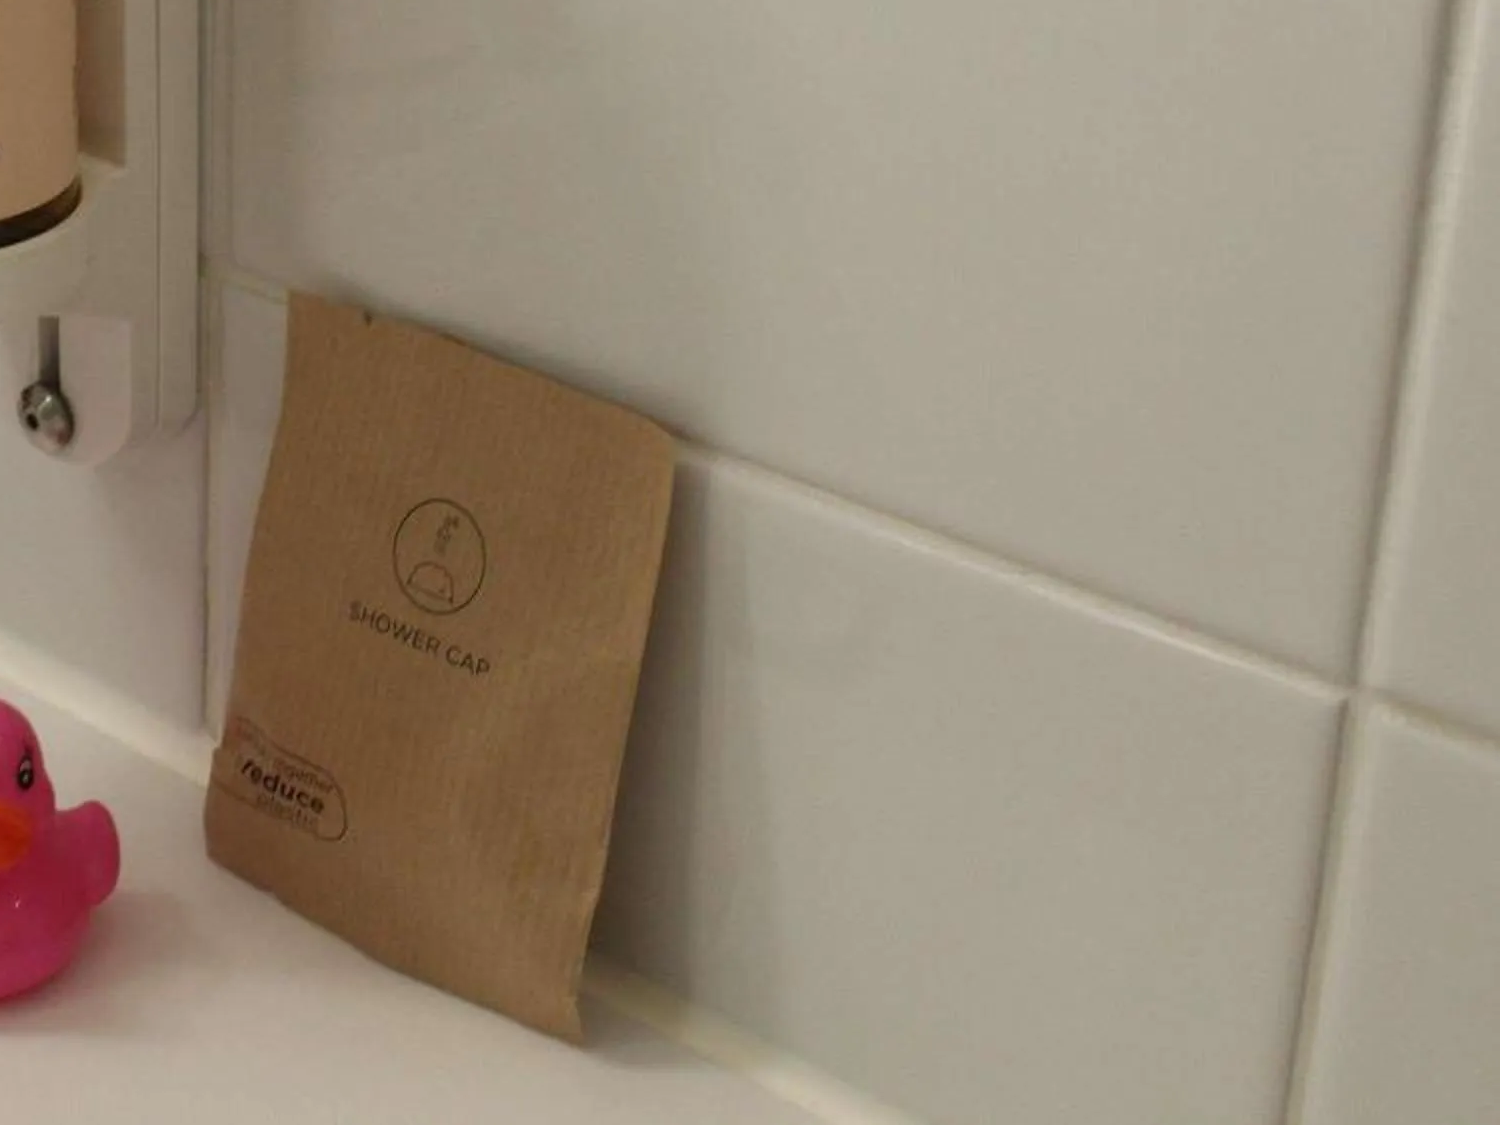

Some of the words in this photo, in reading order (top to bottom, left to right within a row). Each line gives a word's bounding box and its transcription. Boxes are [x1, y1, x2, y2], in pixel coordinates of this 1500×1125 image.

[350, 600, 442, 655] SHOWER
[445, 644, 491, 676] CAP
[241, 758, 325, 814] reduce
